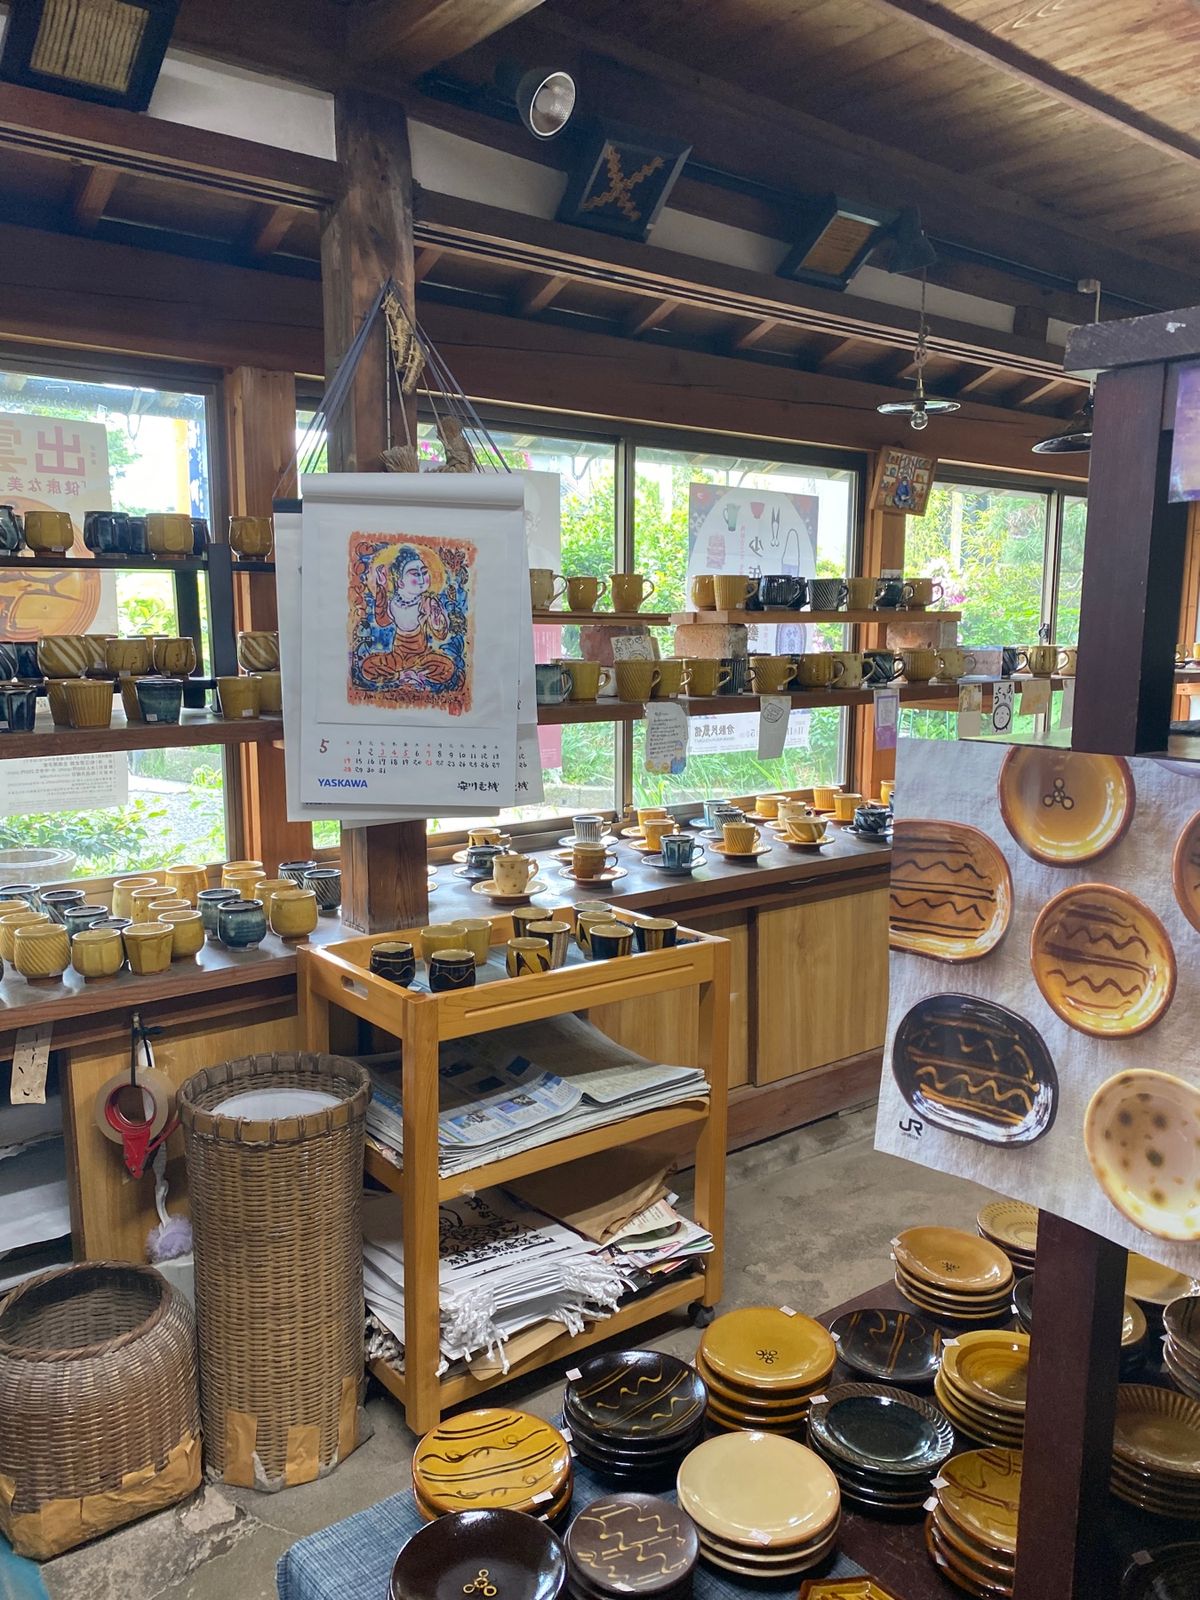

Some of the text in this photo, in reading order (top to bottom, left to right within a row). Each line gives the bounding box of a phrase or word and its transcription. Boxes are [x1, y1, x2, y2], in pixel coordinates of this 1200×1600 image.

[319, 738, 330, 753] 5
[318, 778, 368, 789] YASKAWA
[899, 1118, 924, 1137] JR
